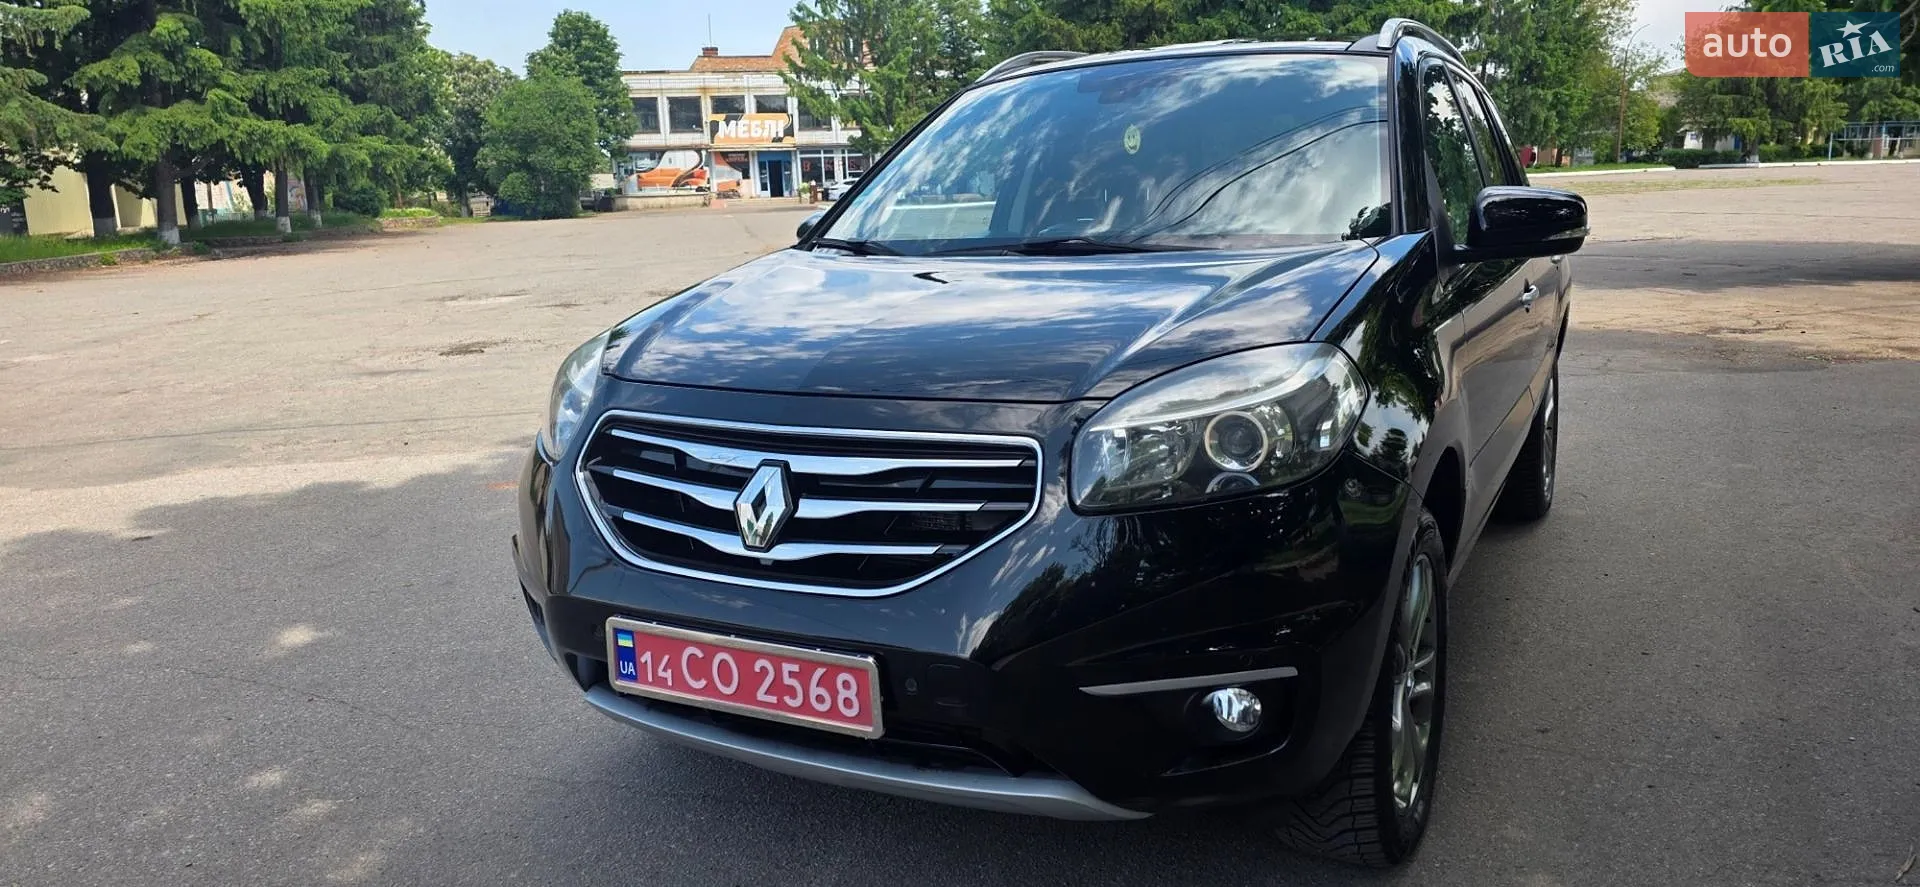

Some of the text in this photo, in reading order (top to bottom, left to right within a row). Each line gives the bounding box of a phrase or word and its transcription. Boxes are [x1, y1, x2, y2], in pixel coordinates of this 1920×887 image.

[718, 119, 785, 139] МЕБЛІ
[619, 660, 636, 677] UA
[640, 646, 860, 718] 14 CO 2568
